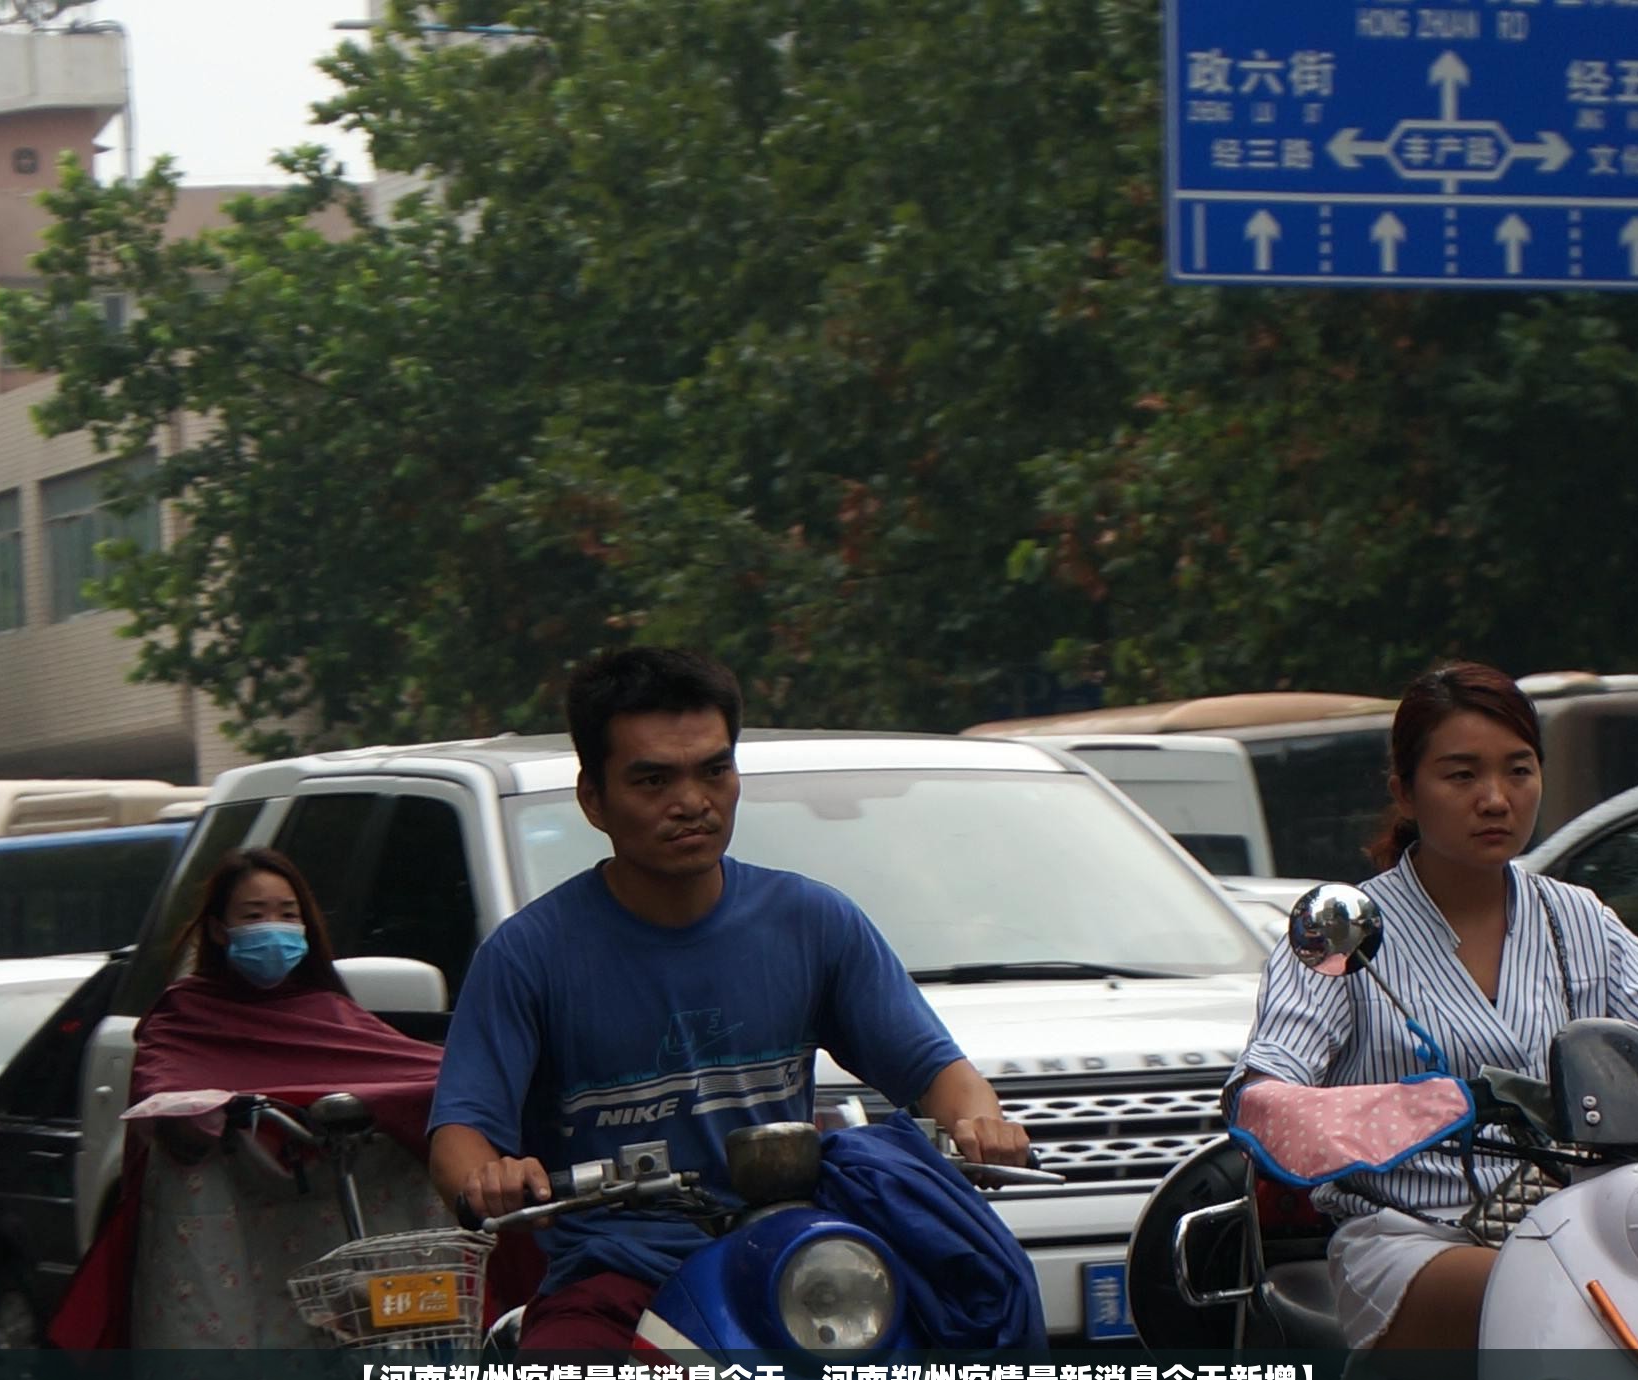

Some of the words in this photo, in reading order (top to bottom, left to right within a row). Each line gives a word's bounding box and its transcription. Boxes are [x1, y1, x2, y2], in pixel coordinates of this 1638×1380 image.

[1188, 48, 1336, 97] 政六街
[1211, 138, 1313, 169] 经三路
[1402, 135, 1497, 166] 丰产路
[977, 1056, 1107, 1076] AND
[596, 1098, 680, 1127] NIKE
